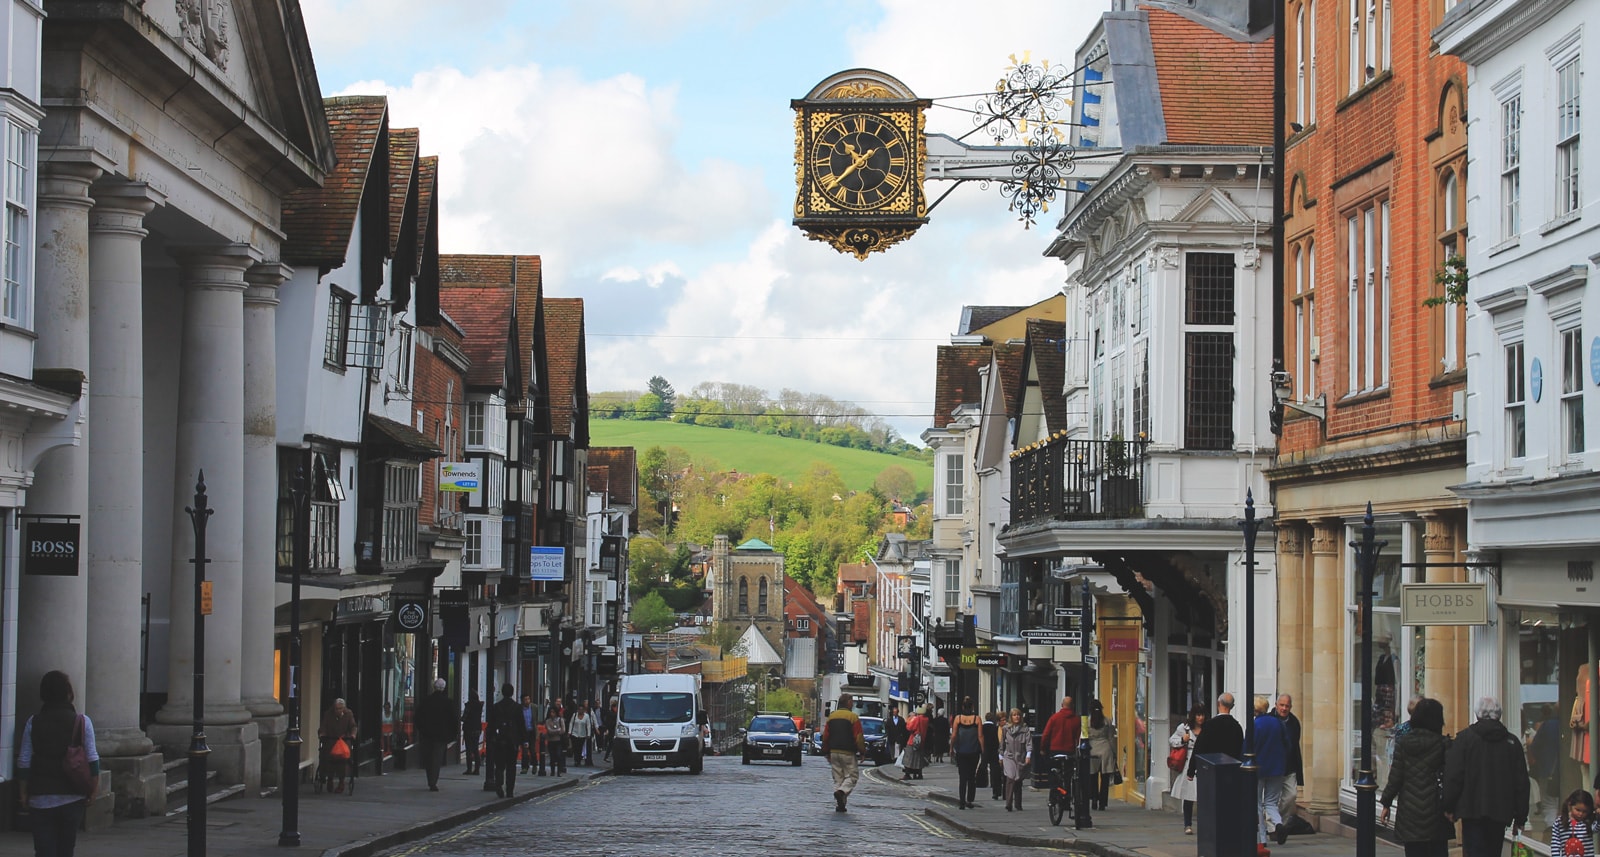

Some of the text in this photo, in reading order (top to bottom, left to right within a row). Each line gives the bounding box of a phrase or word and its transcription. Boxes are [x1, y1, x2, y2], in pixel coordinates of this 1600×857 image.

[848, 233, 875, 245] 1683
[445, 470, 477, 478] Townends
[31, 540, 75, 554] BOSS
[1415, 594, 1474, 608] HOBBS
